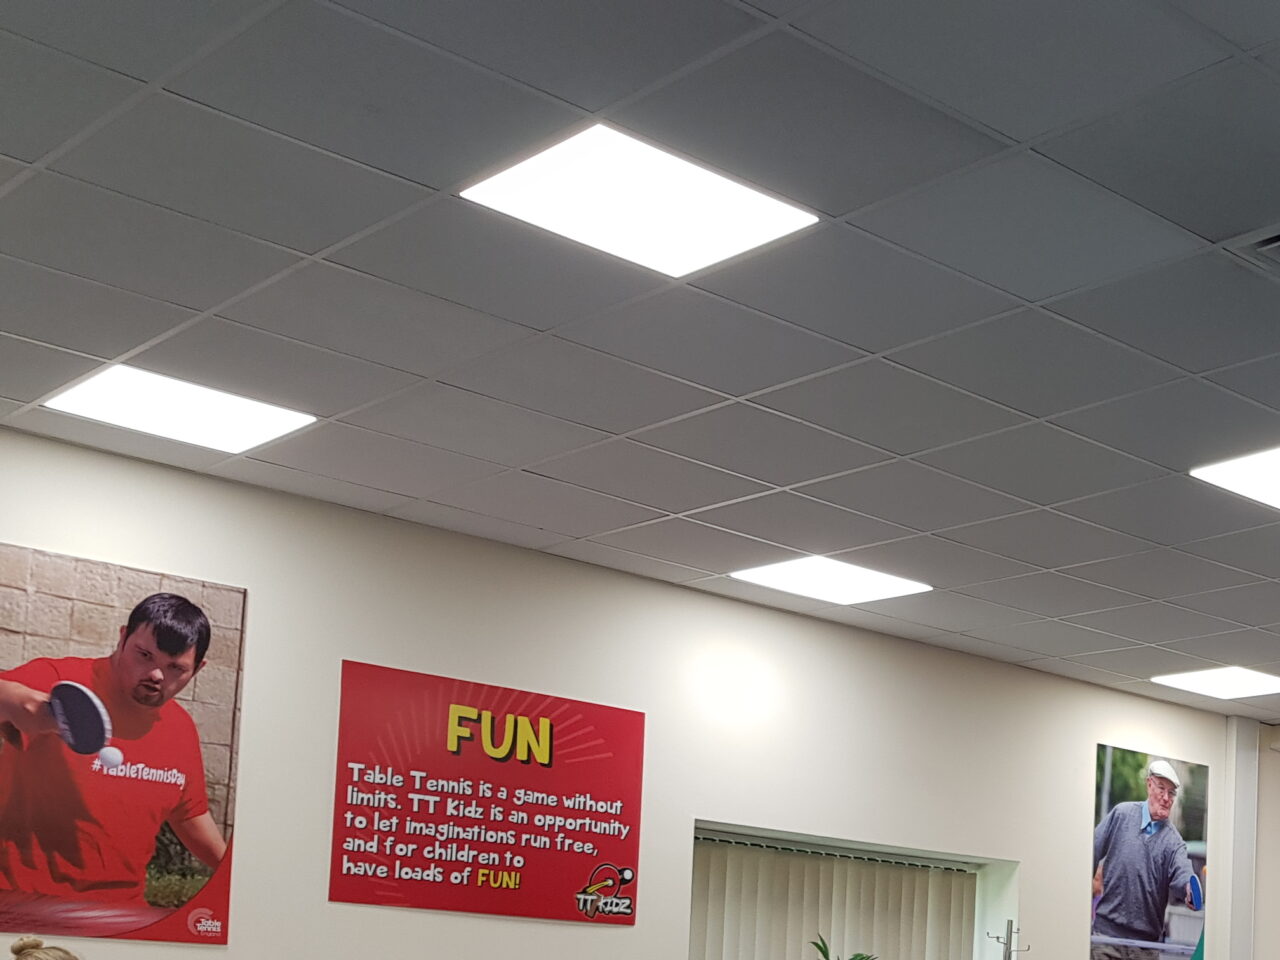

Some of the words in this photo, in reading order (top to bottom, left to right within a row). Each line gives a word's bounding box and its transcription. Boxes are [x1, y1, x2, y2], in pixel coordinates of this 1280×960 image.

[447, 704, 552, 766] FUN
[348, 762, 404, 787] Table
[410, 770, 473, 795] Tennis
[478, 781, 492, 797] is
[497, 787, 508, 799] a
[513, 789, 558, 805] game
[562, 793, 623, 815] without
[346, 785, 401, 809] limits.
[408, 793, 440, 813] TT
[446, 798, 484, 819] Kidz
[490, 804, 503, 821] is
[508, 810, 528, 824] an
[534, 814, 630, 840] opportunity
[343, 834, 378, 854] and
[383, 837, 418, 857] for
[423, 841, 499, 865] children
[504, 851, 525, 867] to
[344, 811, 367, 829] to
[373, 812, 399, 832] let
[405, 817, 516, 844] imaginations
[521, 833, 550, 848] run
[555, 833, 598, 856] free,
[342, 855, 388, 877] have
[395, 860, 443, 882] loads
[450, 867, 472, 885] of
[477, 869, 521, 889] FUN!
[576, 894, 597, 911] TT
[196, 924, 221, 932] Tennis
